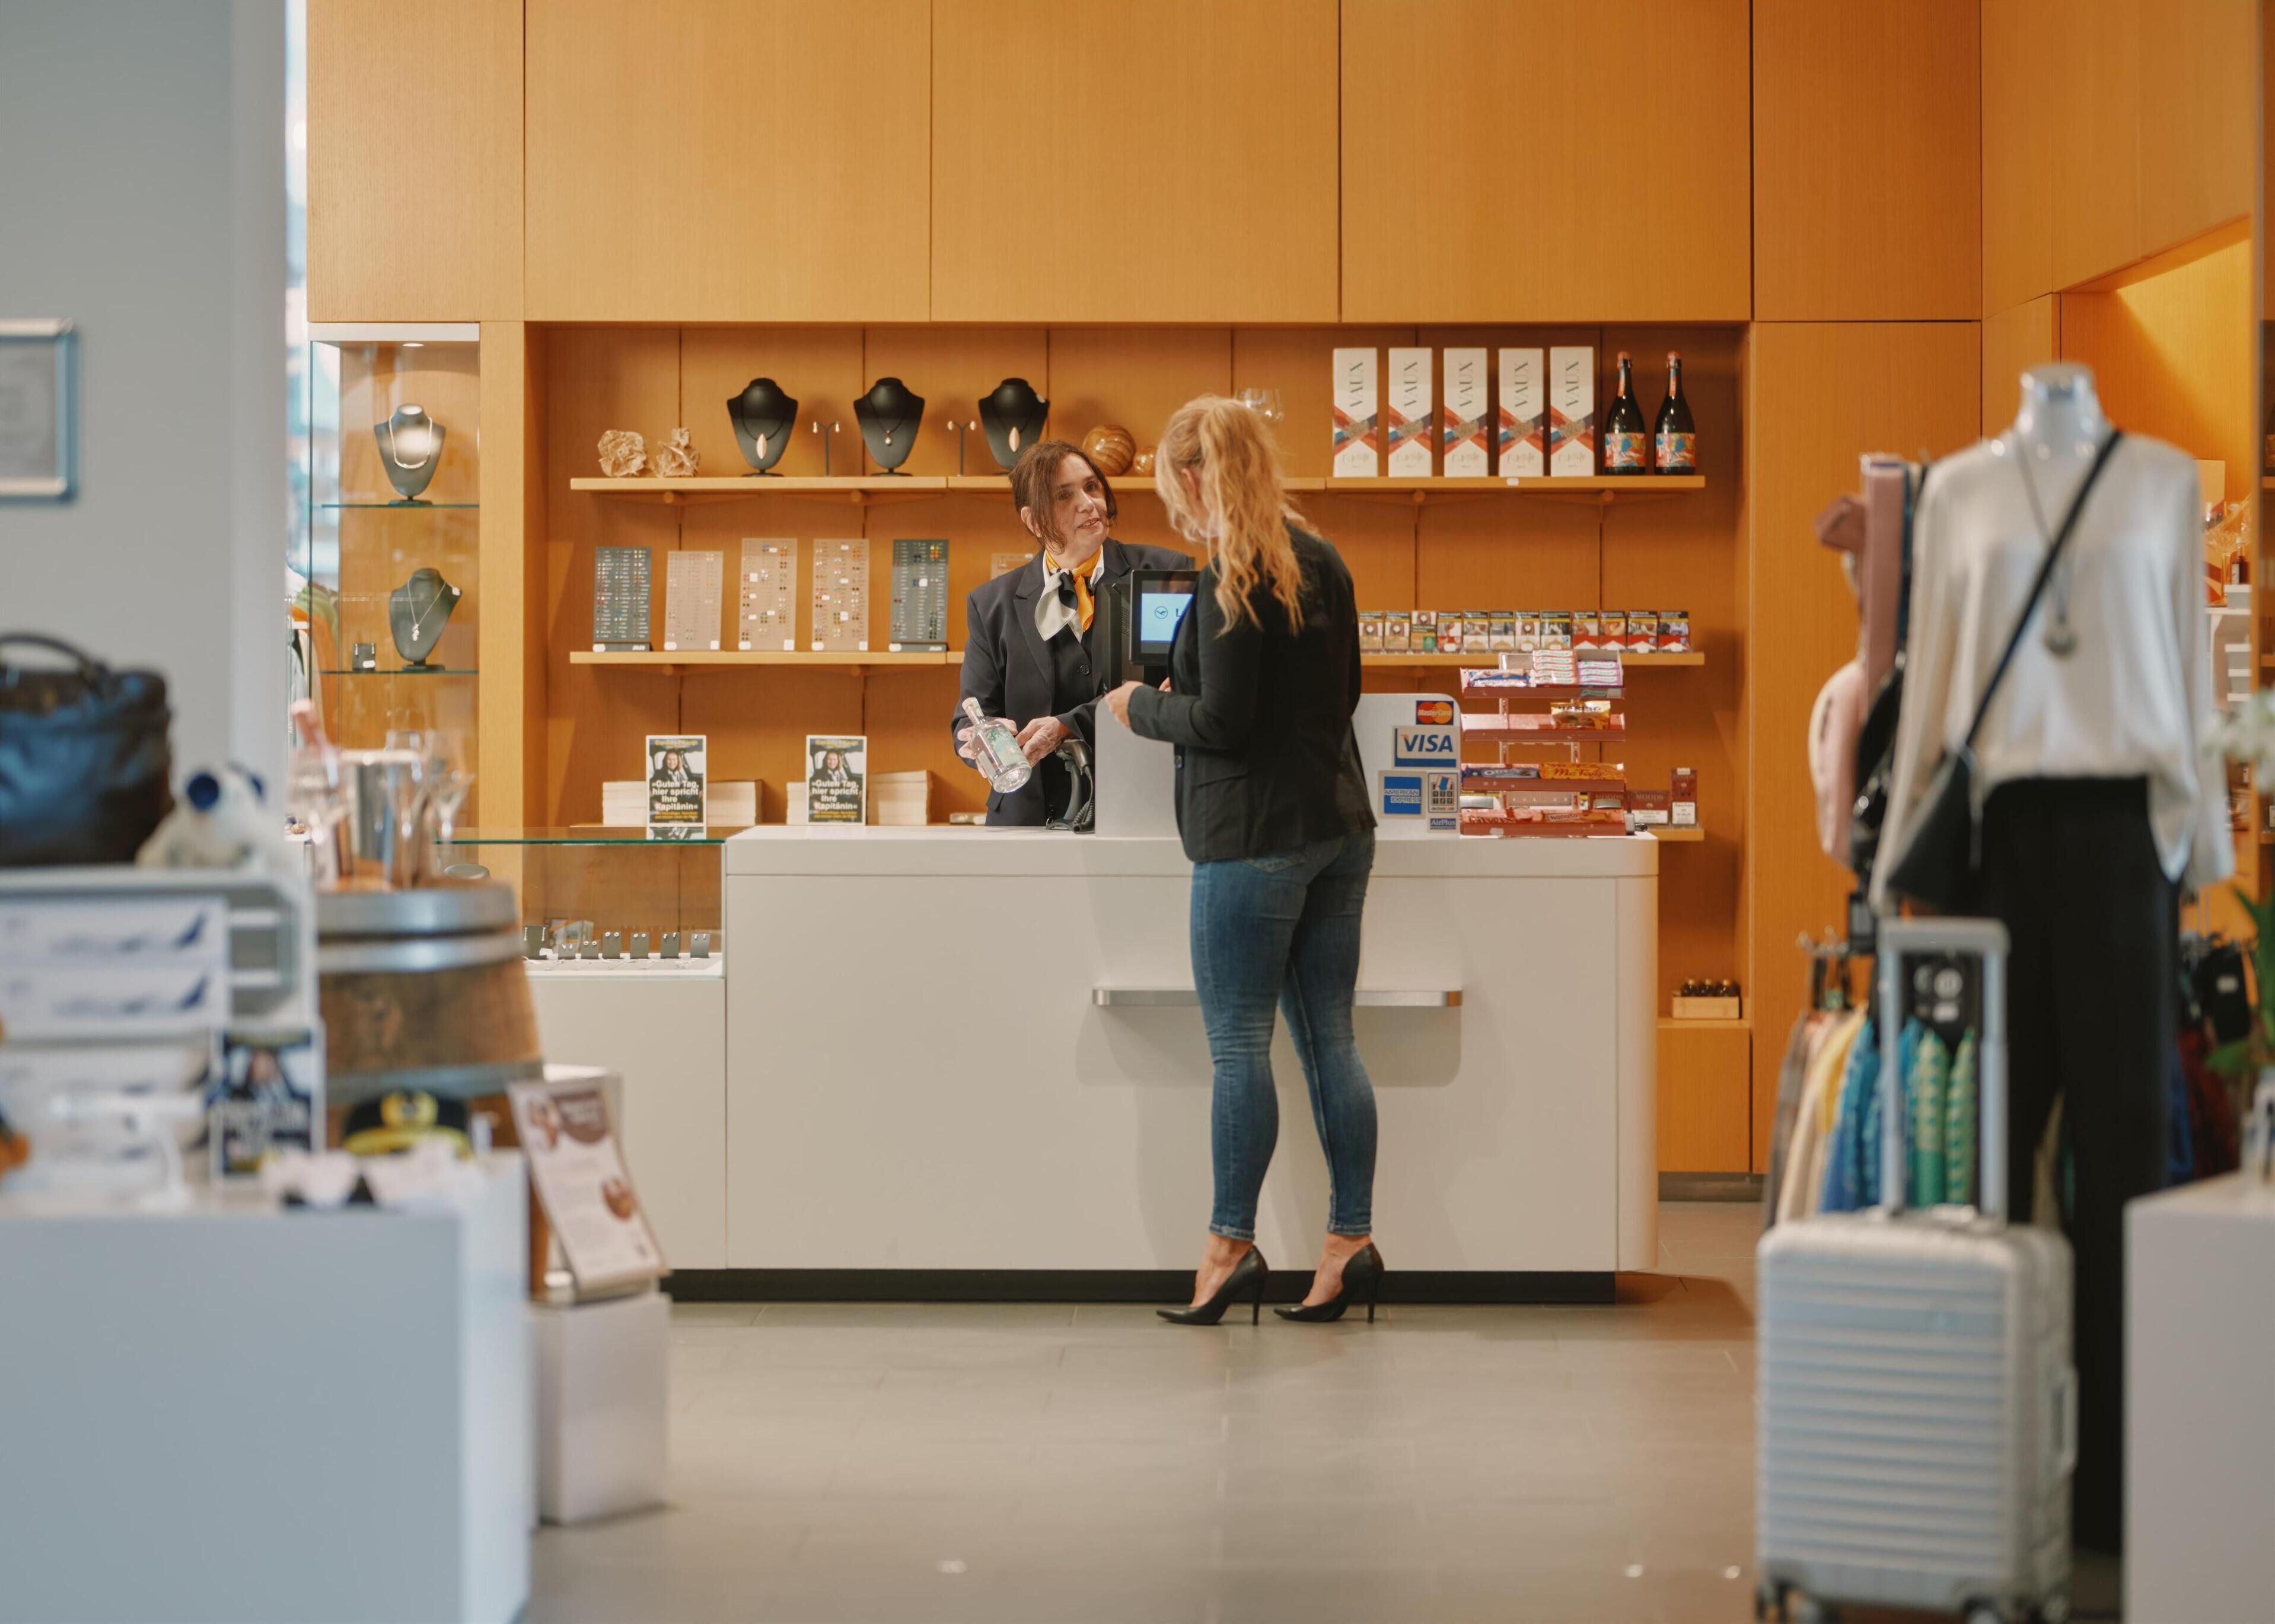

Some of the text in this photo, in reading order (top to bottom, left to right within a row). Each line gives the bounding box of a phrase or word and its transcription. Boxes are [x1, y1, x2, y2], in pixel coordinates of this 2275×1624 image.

[1349, 361, 1363, 407] VAUX
[1403, 361, 1418, 407] VAUX
[1459, 361, 1473, 407] VAUX
[1514, 361, 1528, 407] VAUX
[1565, 360, 1580, 407] VAUX
[1400, 734, 1453, 752] VISA
[670, 787, 699, 796] spricht
[830, 787, 858, 796] spricht
